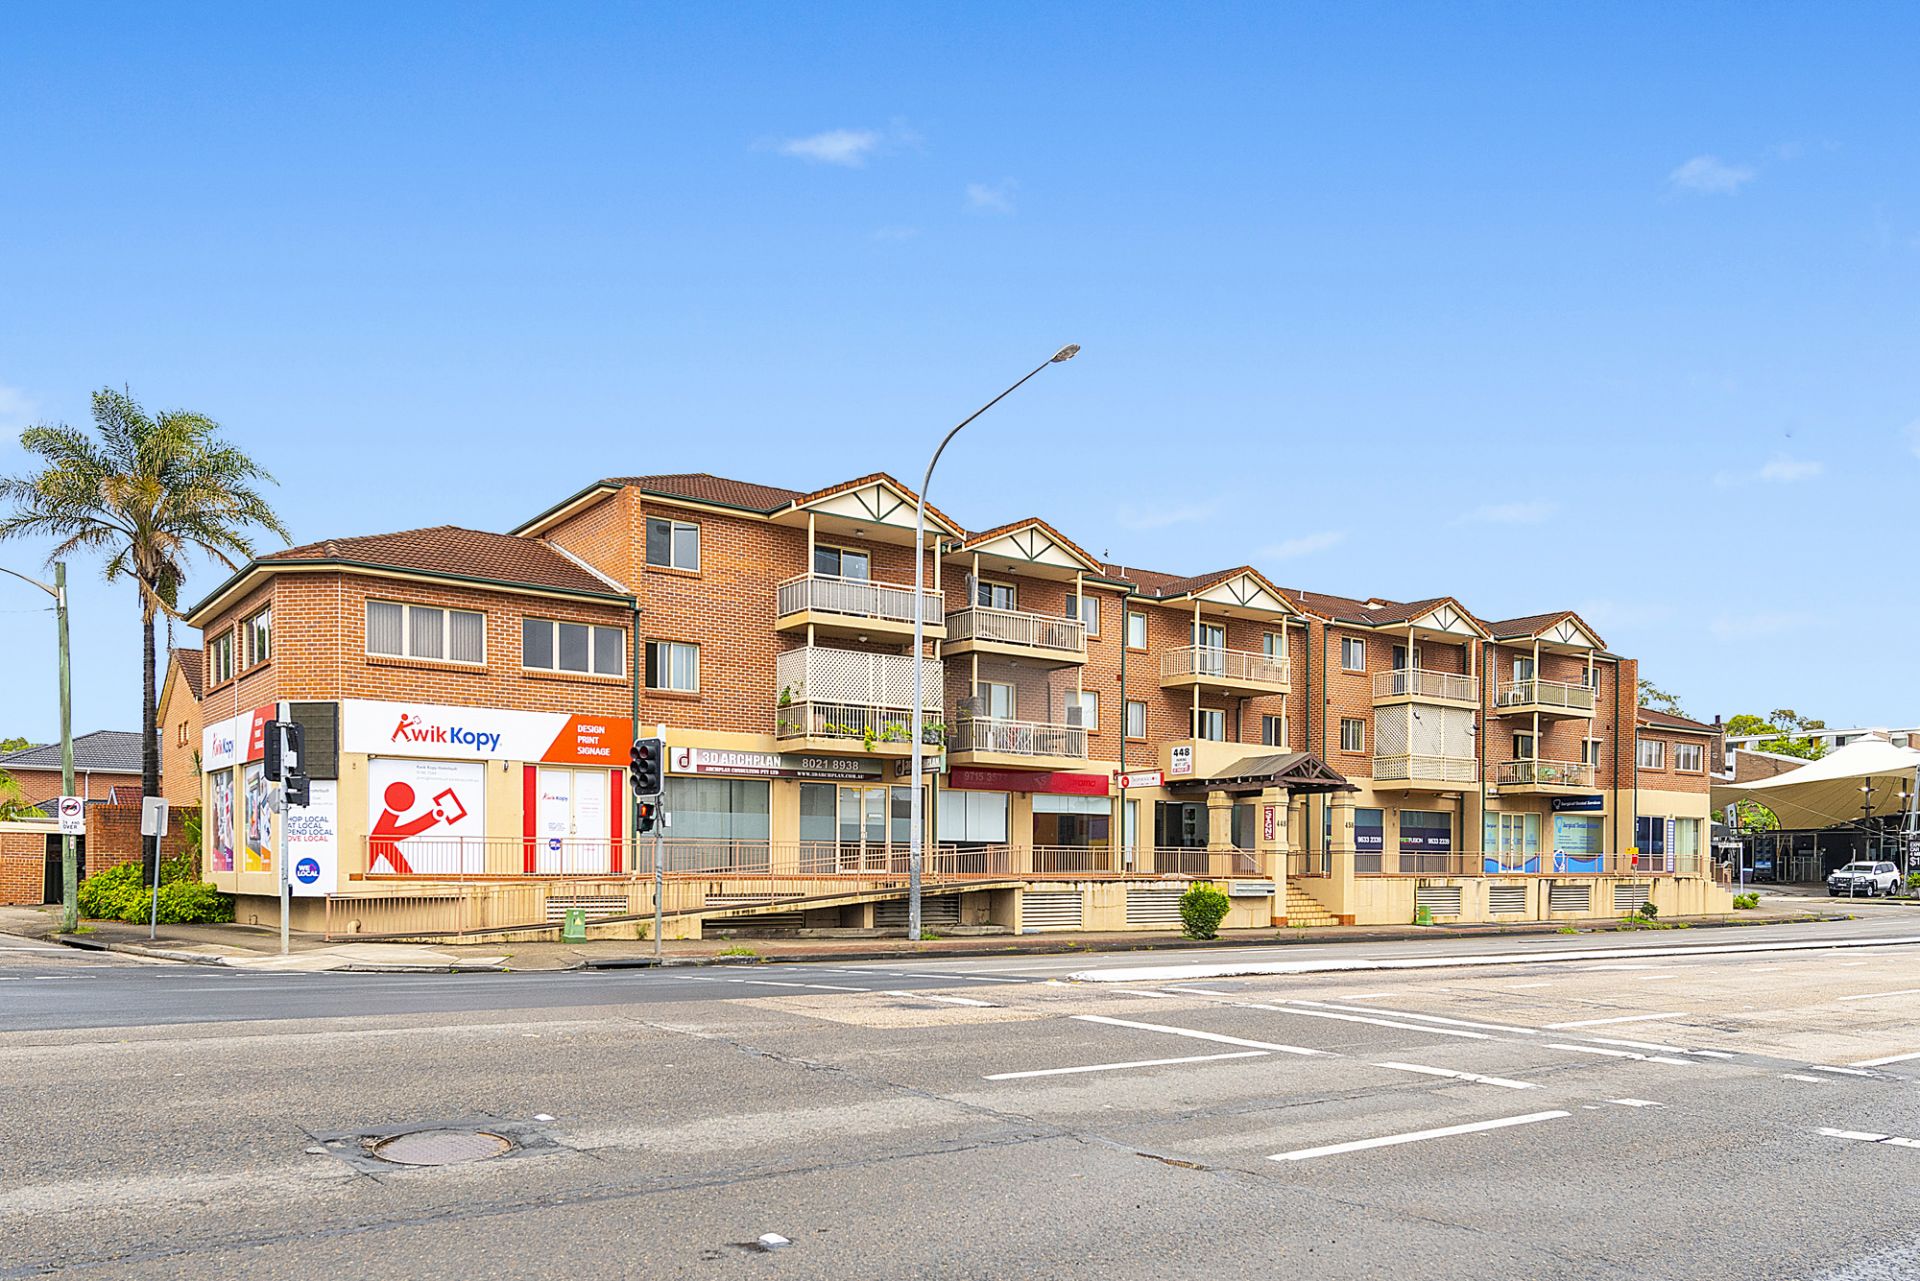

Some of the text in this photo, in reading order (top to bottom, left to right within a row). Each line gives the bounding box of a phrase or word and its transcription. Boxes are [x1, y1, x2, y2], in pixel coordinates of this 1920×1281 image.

[391, 713, 501, 752] Kwik Kopy
[577, 725, 605, 734] DESIGN
[577, 736, 599, 744] PRINT
[577, 746, 611, 756] SIGNAGE
[1173, 747, 1190, 757] 448
[702, 751, 782, 767] 3D ARCHPLAN
[802, 758, 859, 771] 8021 8938
